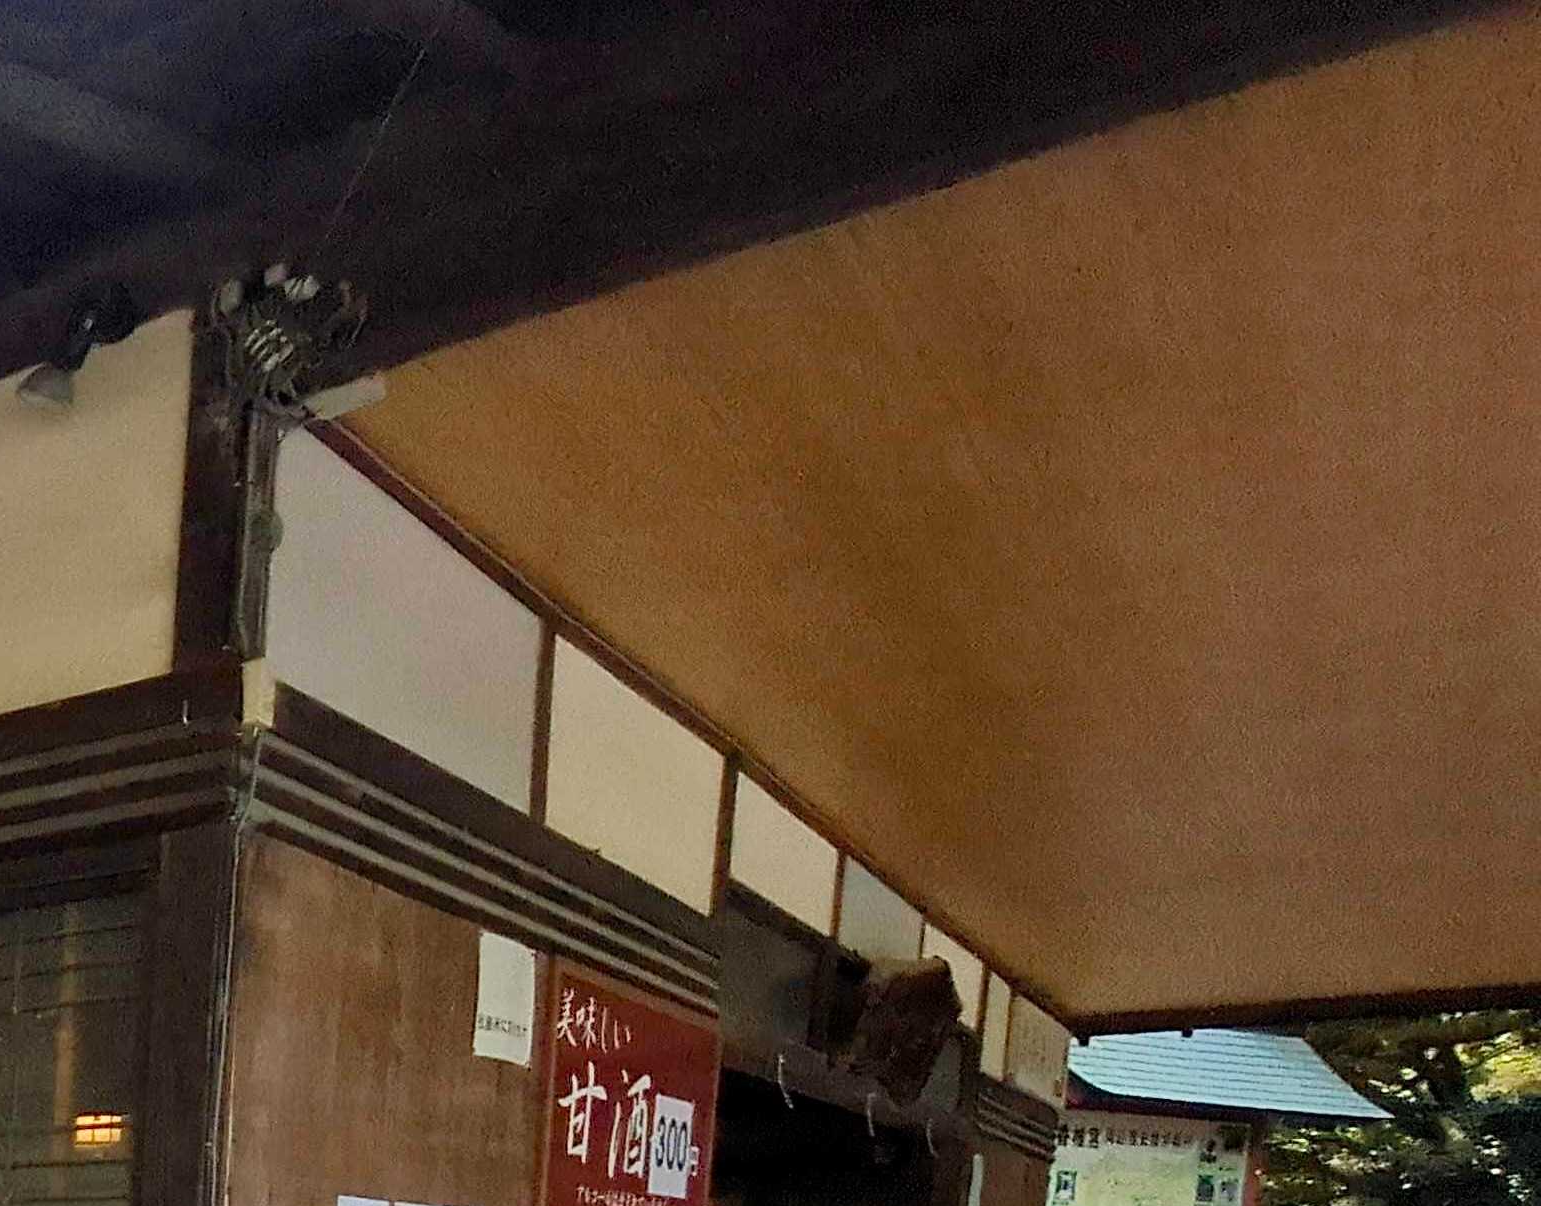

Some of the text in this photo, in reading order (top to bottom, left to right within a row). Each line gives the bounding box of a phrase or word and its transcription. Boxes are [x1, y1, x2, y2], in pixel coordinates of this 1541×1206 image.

[556, 987, 631, 1053] 美味しい
[558, 1061, 651, 1178] 甘酒
